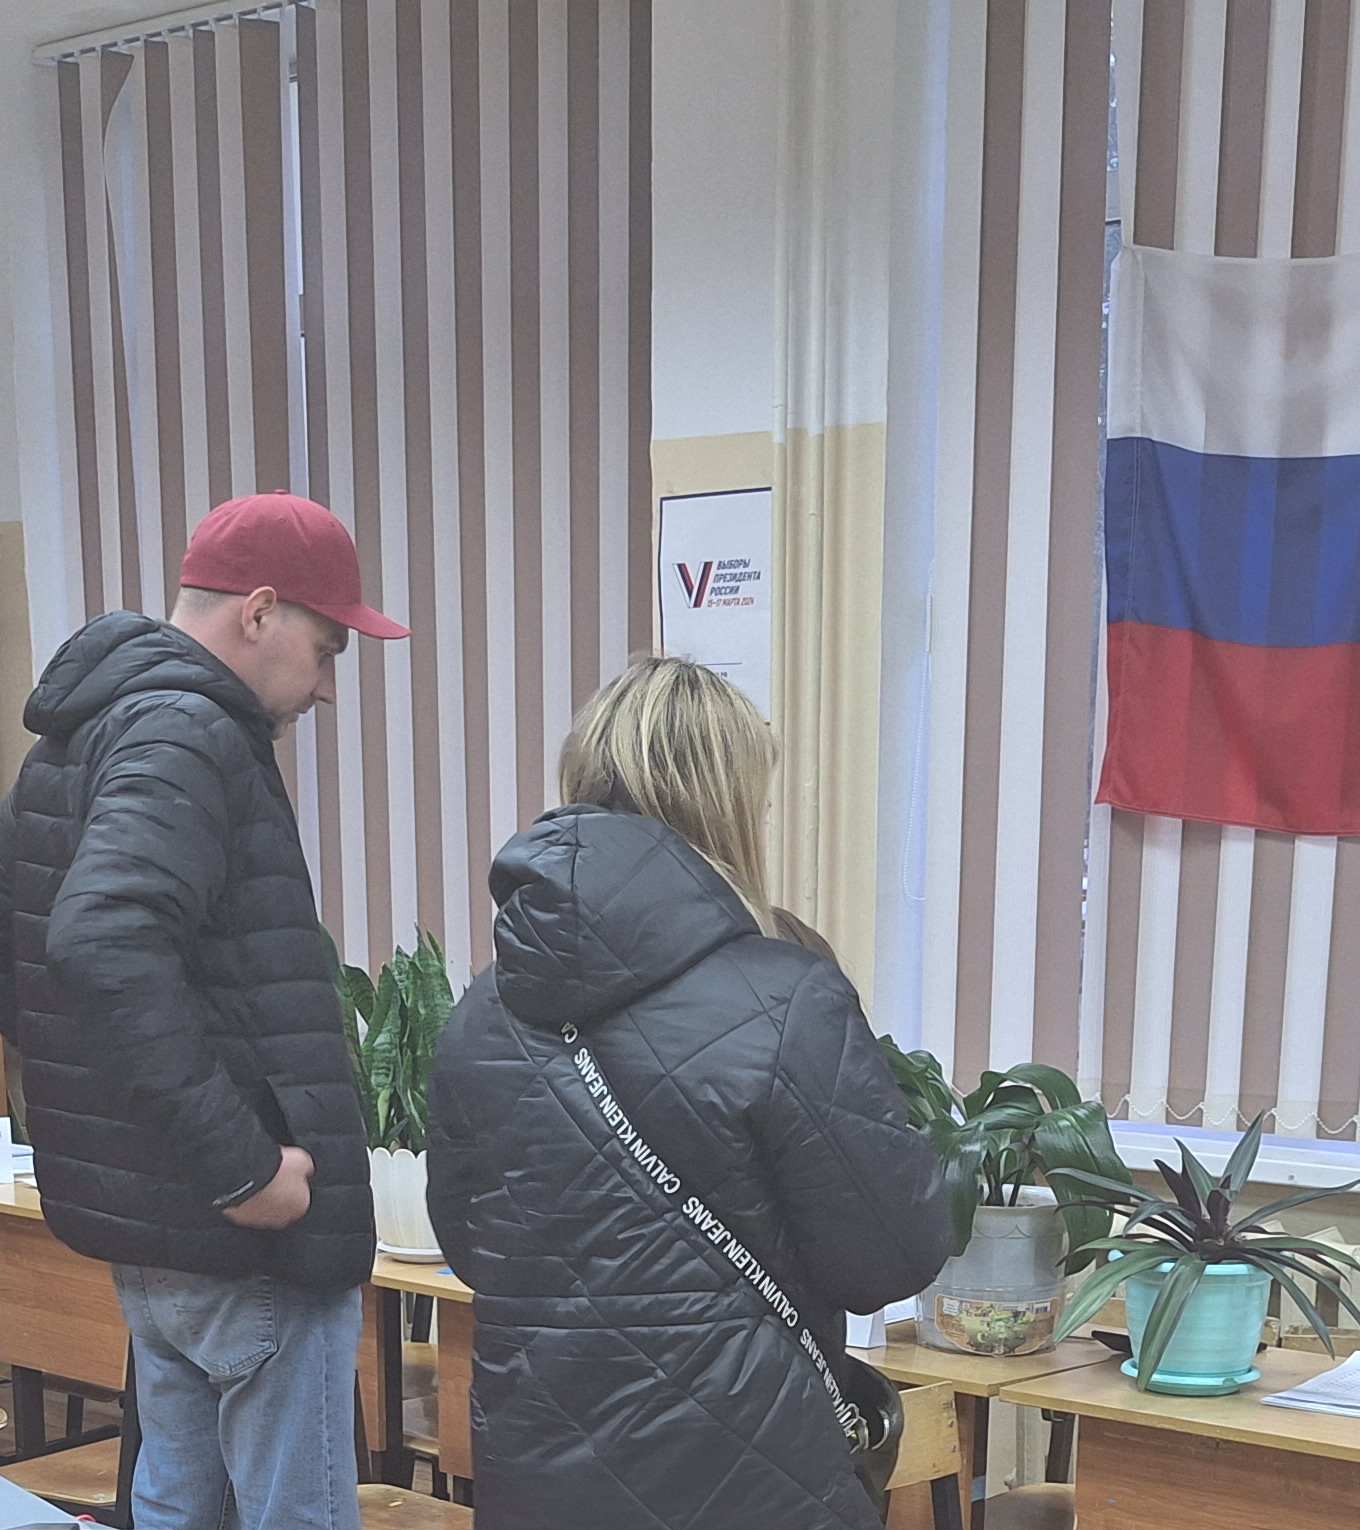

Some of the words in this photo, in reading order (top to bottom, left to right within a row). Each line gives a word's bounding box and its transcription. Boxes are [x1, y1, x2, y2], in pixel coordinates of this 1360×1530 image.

[713, 571, 761, 583] ПРЕЗИДЕНТА
[717, 558, 751, 570] ВЫБОРЫ
[710, 585, 740, 596] РОССИИ
[574, 1047, 608, 1098] JEANS
[599, 1094, 638, 1145] KLEIN
[629, 1138, 681, 1194] CALVIN
[682, 1196, 732, 1245] JEANS
[722, 1238, 765, 1285] KLEIN
[758, 1275, 798, 1327] CALVIN
[800, 1328, 828, 1373] JEANS
[822, 1366, 843, 1408] KLEIN
